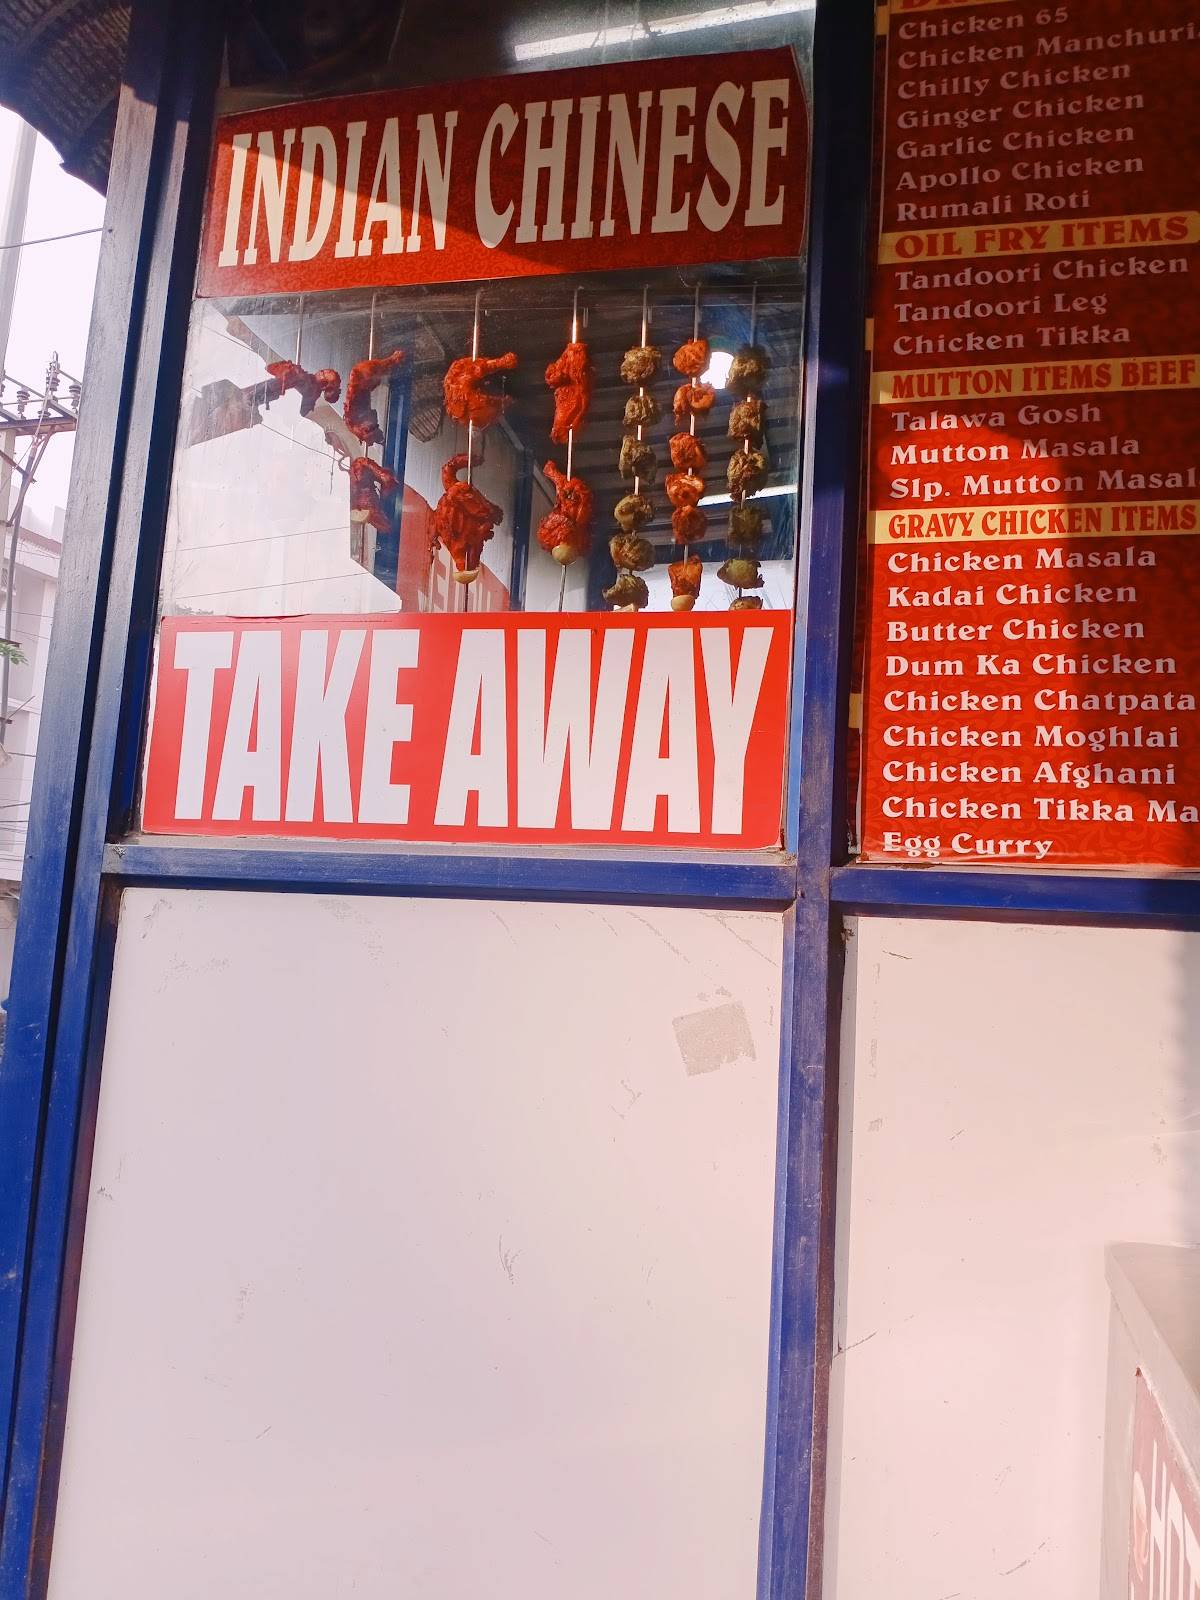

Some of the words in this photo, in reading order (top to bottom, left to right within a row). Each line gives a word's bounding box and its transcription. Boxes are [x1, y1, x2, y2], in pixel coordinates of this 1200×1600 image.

[899, 14, 1024, 39] Chicken
[1036, 7, 1069, 25] 65
[899, 44, 1024, 69] Chicken
[1036, 22, 1200, 56] Manchuri
[898, 77, 991, 99] Chilly
[1000, 63, 1131, 90] Chicken
[897, 106, 1002, 129] Ginger
[1012, 94, 1144, 119] Chicken
[897, 136, 992, 159] Garlic
[1003, 126, 1135, 150] Chicken
[218, 110, 458, 268] INDIAN
[474, 78, 790, 250] CHINESE
[896, 167, 1000, 192] Apollo
[1011, 157, 1144, 180] Chicken
[897, 195, 1012, 222] Rumali
[1024, 190, 1090, 212] Roti
[895, 232, 962, 258] OIL
[974, 225, 1049, 253] FRY
[1061, 216, 1189, 247] ITEMS
[895, 263, 1041, 290] Tandoori
[1053, 256, 1188, 280] Chicken
[894, 296, 1041, 323] Tandoori
[1053, 292, 1108, 315] Leg
[893, 332, 1024, 355] Chicken
[1036, 325, 1131, 347] Tikka
[891, 368, 1012, 399] MUTTON
[1022, 363, 1112, 392] ITEMS
[1121, 359, 1196, 388] BEEF
[891, 410, 1006, 432] Talawa
[1018, 403, 1101, 426] Gosh
[890, 444, 1009, 465] Mutton
[1021, 436, 1140, 459] Masala
[889, 478, 951, 502] Slp.
[961, 475, 1084, 496] Mutton
[1096, 467, 1200, 490] Masal
[888, 511, 974, 539] GRAVY
[981, 508, 1103, 535] CHICKEN
[1111, 504, 1196, 532] ITEMS
[888, 550, 1023, 573] Chicken
[1035, 546, 1156, 569] Masala
[887, 586, 984, 607] Kadai
[996, 583, 1136, 604] Chicken
[887, 621, 992, 642] Butter
[1002, 618, 1145, 639] Chicken
[886, 655, 963, 676] Dum
[976, 655, 1021, 675] Ka
[1032, 654, 1176, 674] Chicken
[884, 690, 1022, 711] Chicken
[1034, 689, 1196, 715] Chatpata
[173, 629, 421, 825] TAKE
[433, 626, 774, 835] AWAY
[883, 726, 1022, 747] Chicken
[1034, 725, 1179, 752] Moghlai
[882, 761, 1021, 782] Chicken
[1033, 761, 1176, 788] Afghani
[882, 796, 1021, 819] Chicken
[1033, 798, 1134, 821] Tikka
[1147, 800, 1199, 823] Ma
[883, 831, 940, 857] Egg
[951, 832, 1053, 859] Curry
